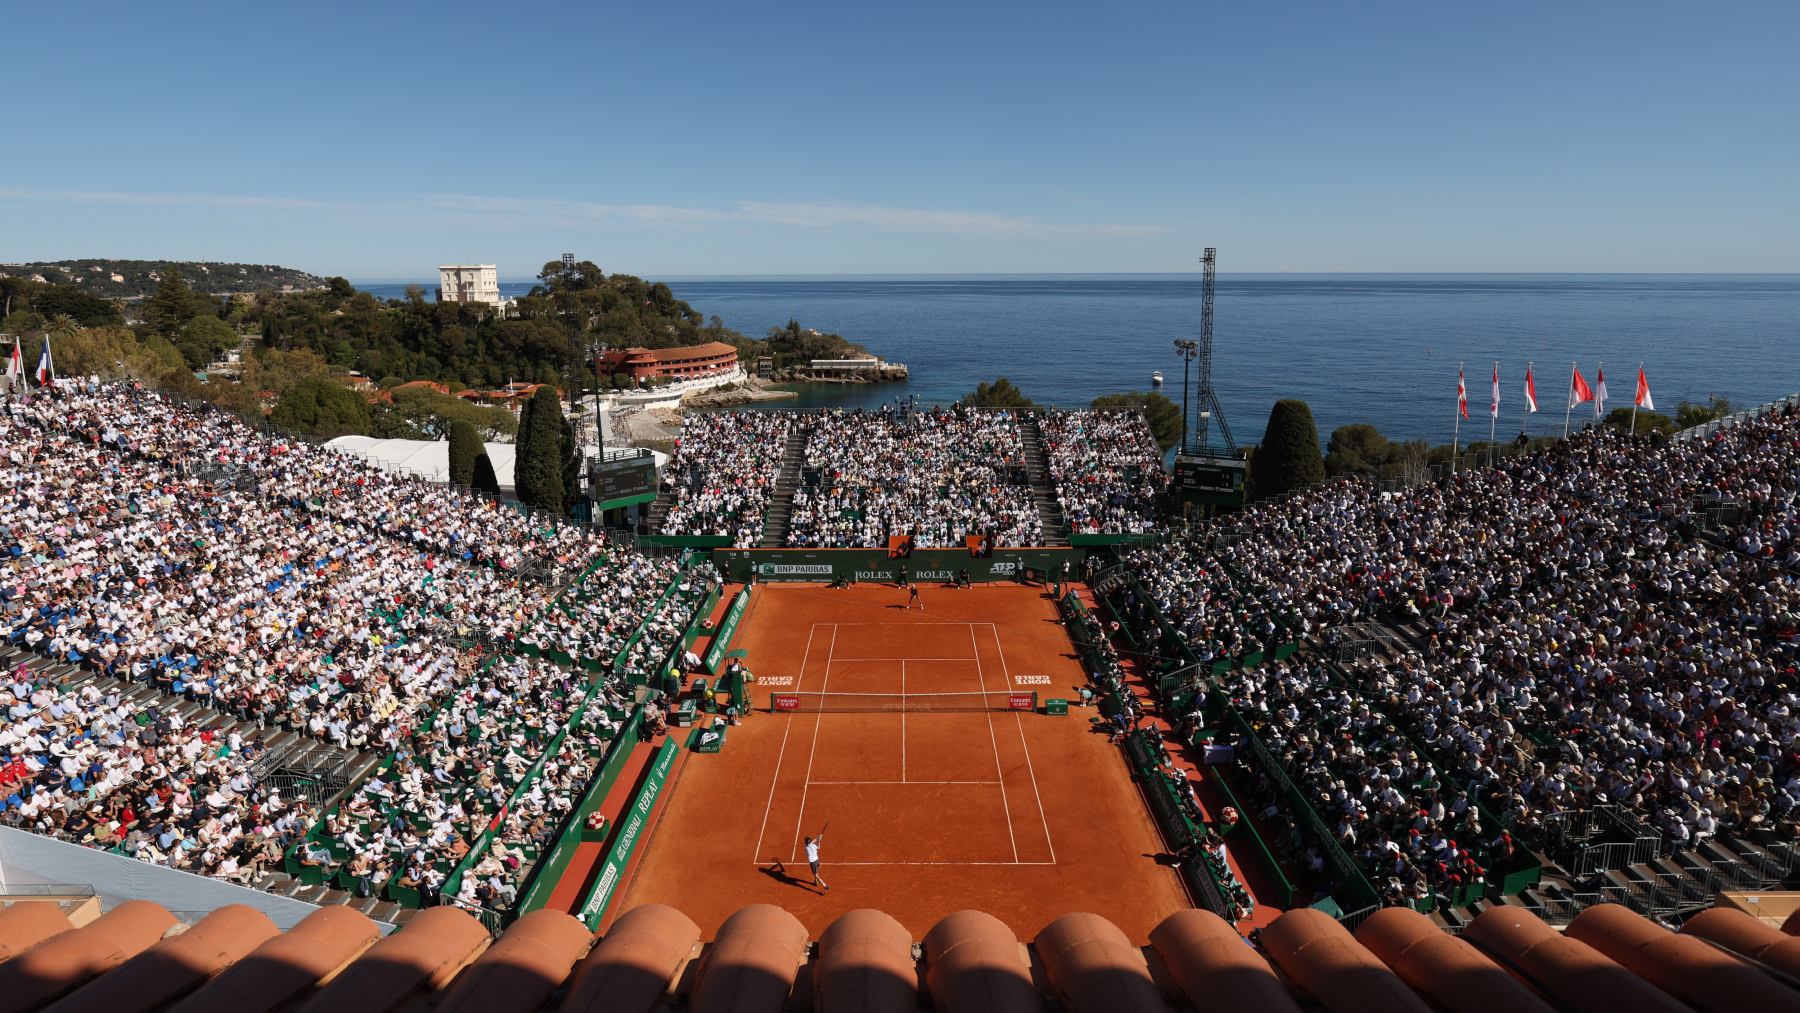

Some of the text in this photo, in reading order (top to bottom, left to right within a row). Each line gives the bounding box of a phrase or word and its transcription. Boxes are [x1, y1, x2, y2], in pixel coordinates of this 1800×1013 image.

[855, 571, 893, 579] ROLEX
[916, 571, 954, 579] ROLEX
[990, 562, 1016, 573] ATP
[638, 778, 658, 814] REPLAY
[621, 814, 642, 851] GENERALI
[599, 865, 615, 895] PARIBAS
